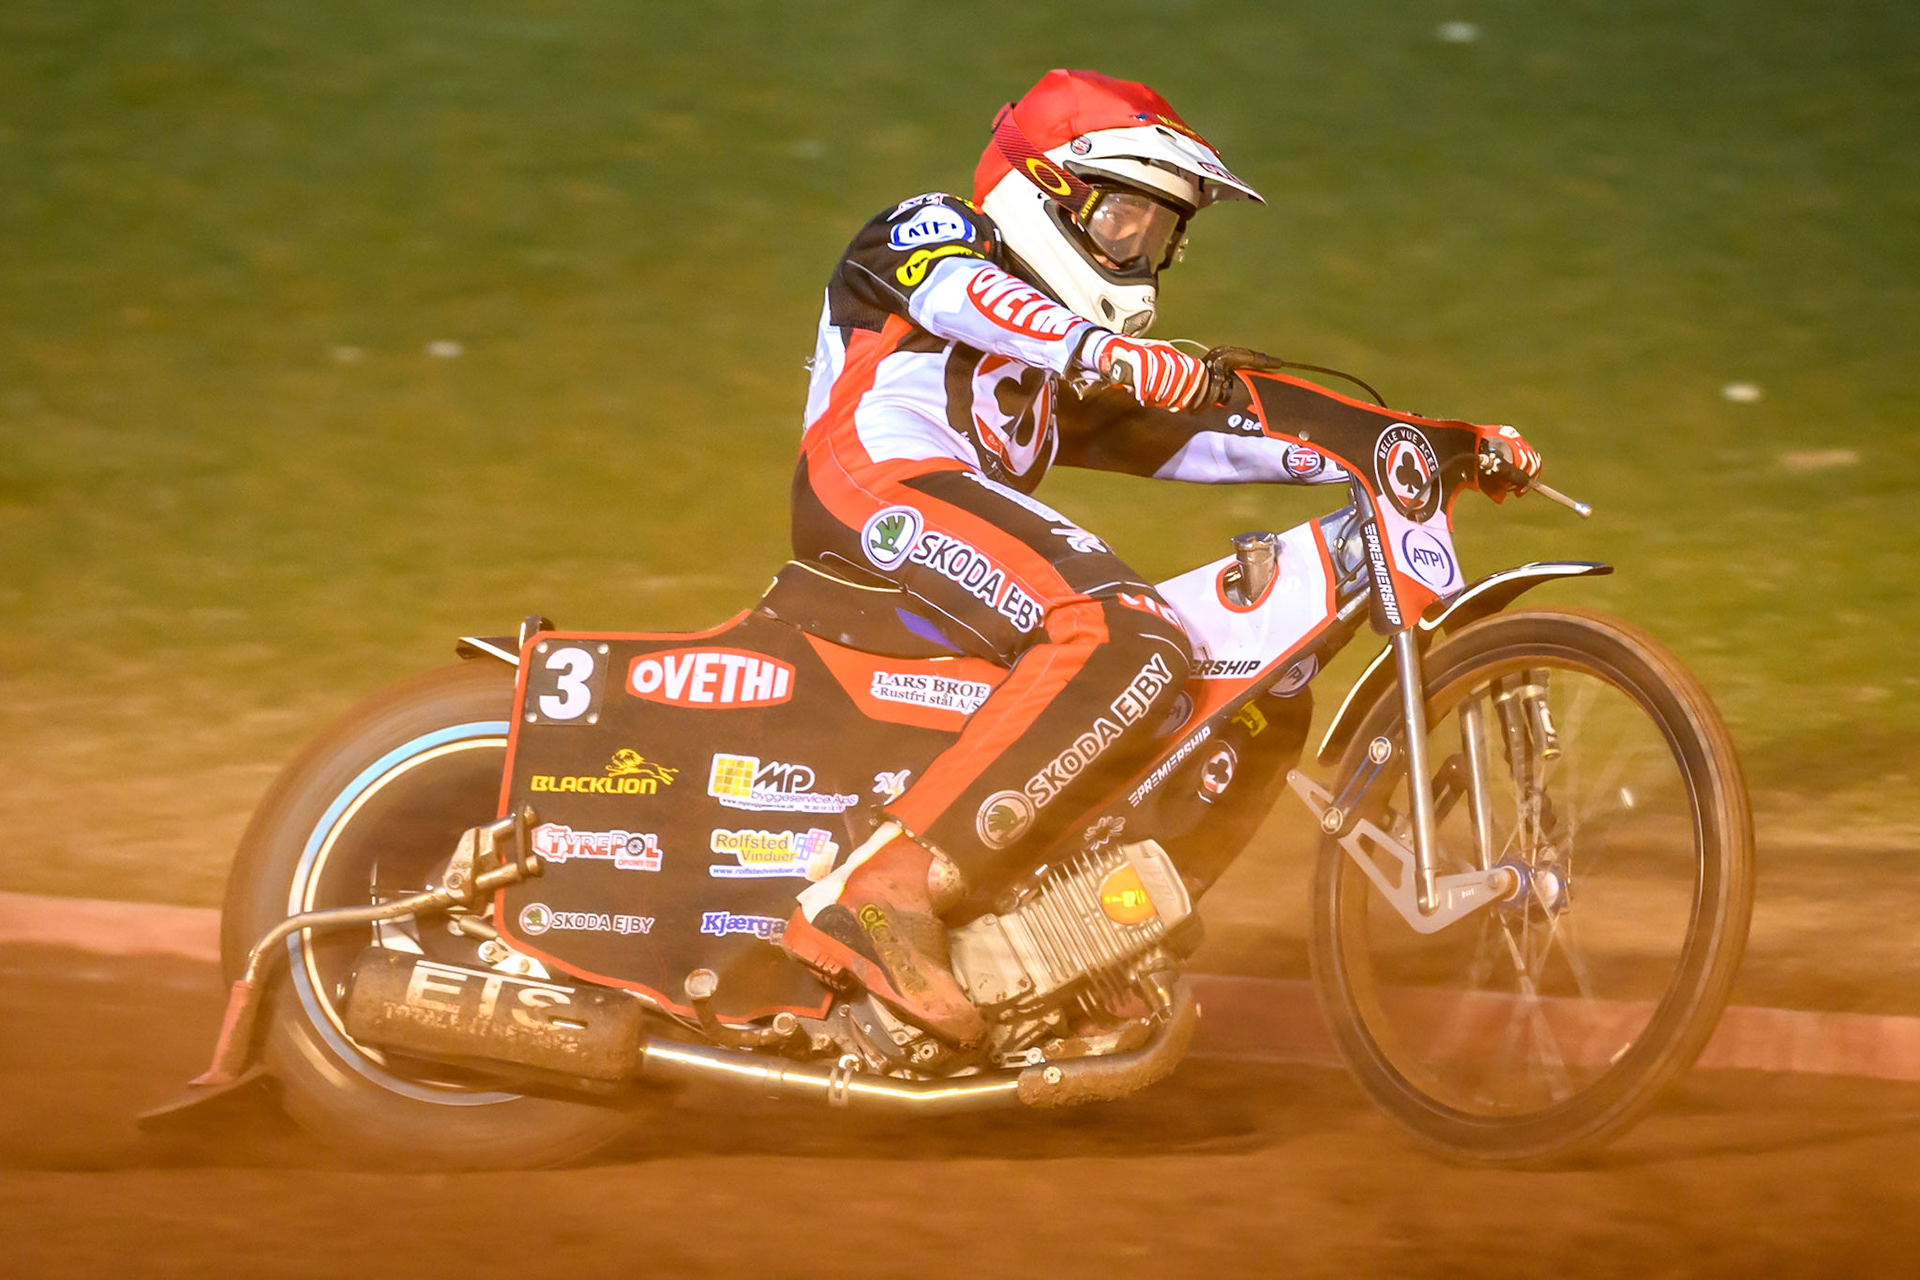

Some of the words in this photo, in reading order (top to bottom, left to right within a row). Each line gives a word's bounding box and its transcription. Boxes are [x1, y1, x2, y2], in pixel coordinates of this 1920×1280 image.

[1289, 453, 1318, 466] STS
[1379, 430, 1398, 459] BELLE
[1400, 429, 1418, 443] VUE
[1420, 443, 1437, 472] ACES
[913, 534, 1001, 603] SKODA
[1413, 548, 1446, 570] ATPI
[1367, 534, 1402, 625] PREMIERSHIP
[632, 652, 789, 703] OVETHI
[1190, 661, 1261, 676] ERSHIP
[538, 647, 595, 720] 3
[876, 674, 928, 689] LARS
[932, 678, 987, 699] BROE
[874, 686, 926, 702] -Rustfri
[928, 693, 953, 707] stål
[1027, 721, 1120, 805] SKODA
[1113, 656, 1170, 722] EJBY
[1136, 726, 1211, 802] PREMIERSHIP
[531, 774, 658, 795] BLACKLION
[754, 765, 812, 793] MP
[716, 833, 789, 850] Rolfsted
[741, 849, 797, 863] Vinduer
[553, 913, 611, 930] SKODA
[615, 917, 655, 933] EJBY
[703, 914, 786, 937] Kjærga
[406, 960, 576, 1030] ETS
